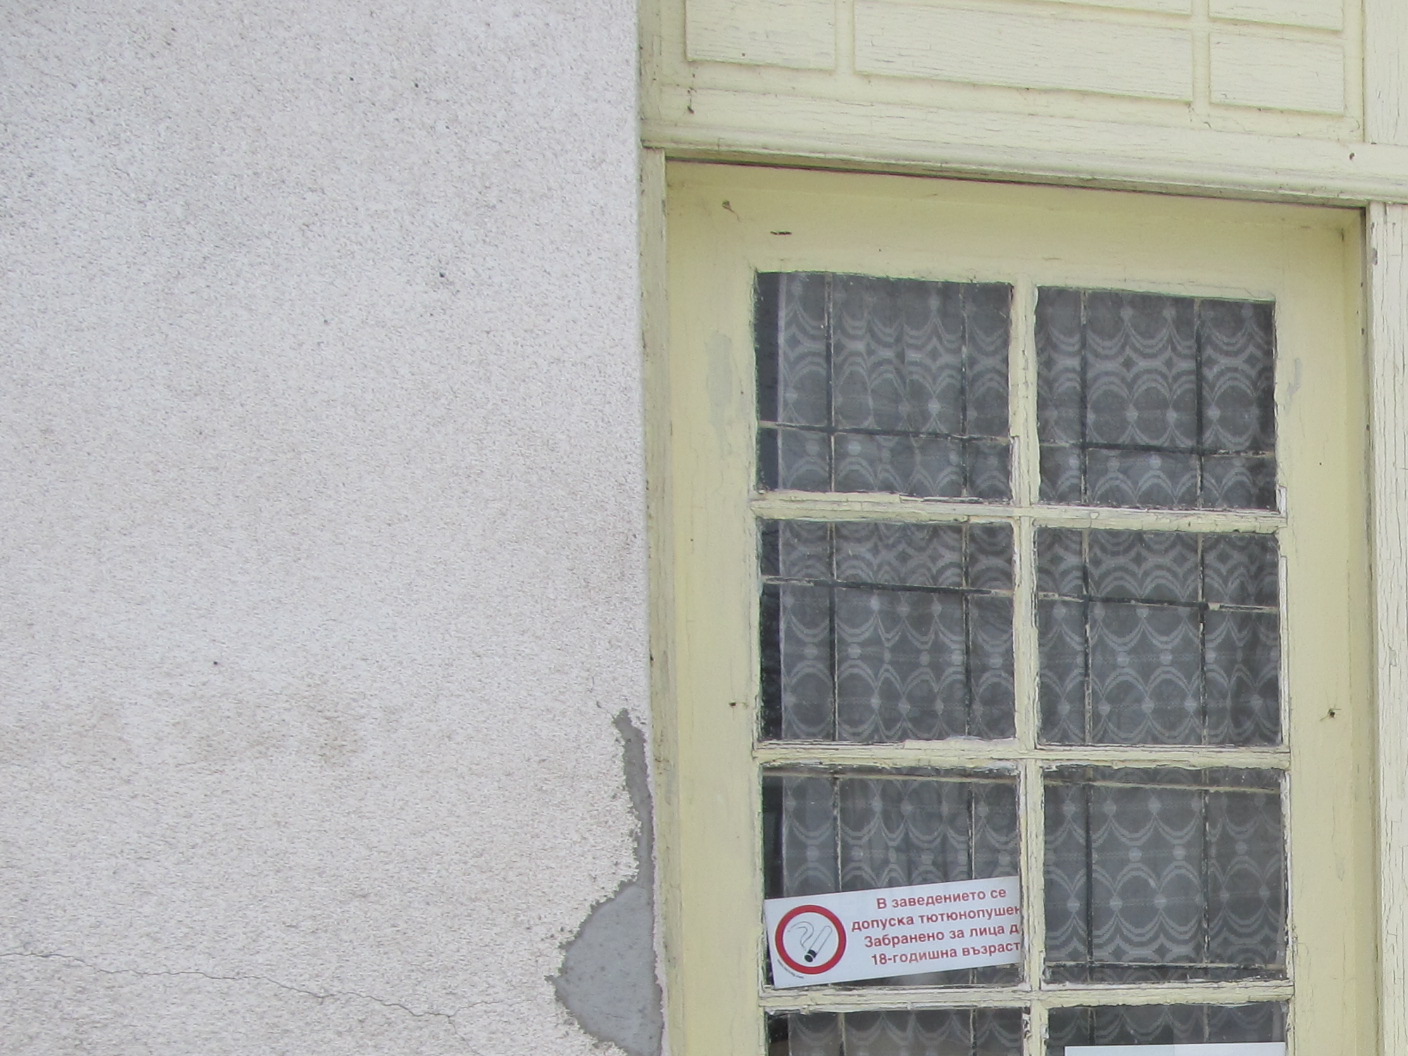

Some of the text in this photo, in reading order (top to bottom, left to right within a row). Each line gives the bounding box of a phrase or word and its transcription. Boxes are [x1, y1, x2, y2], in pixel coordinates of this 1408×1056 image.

[876, 888, 1007, 910] В заведението се
[851, 914, 915, 933] допуска
[864, 930, 945, 949] Забранено
[949, 928, 965, 940] за
[969, 925, 1005, 939] лица
[871, 947, 958, 966] 18-годишна
